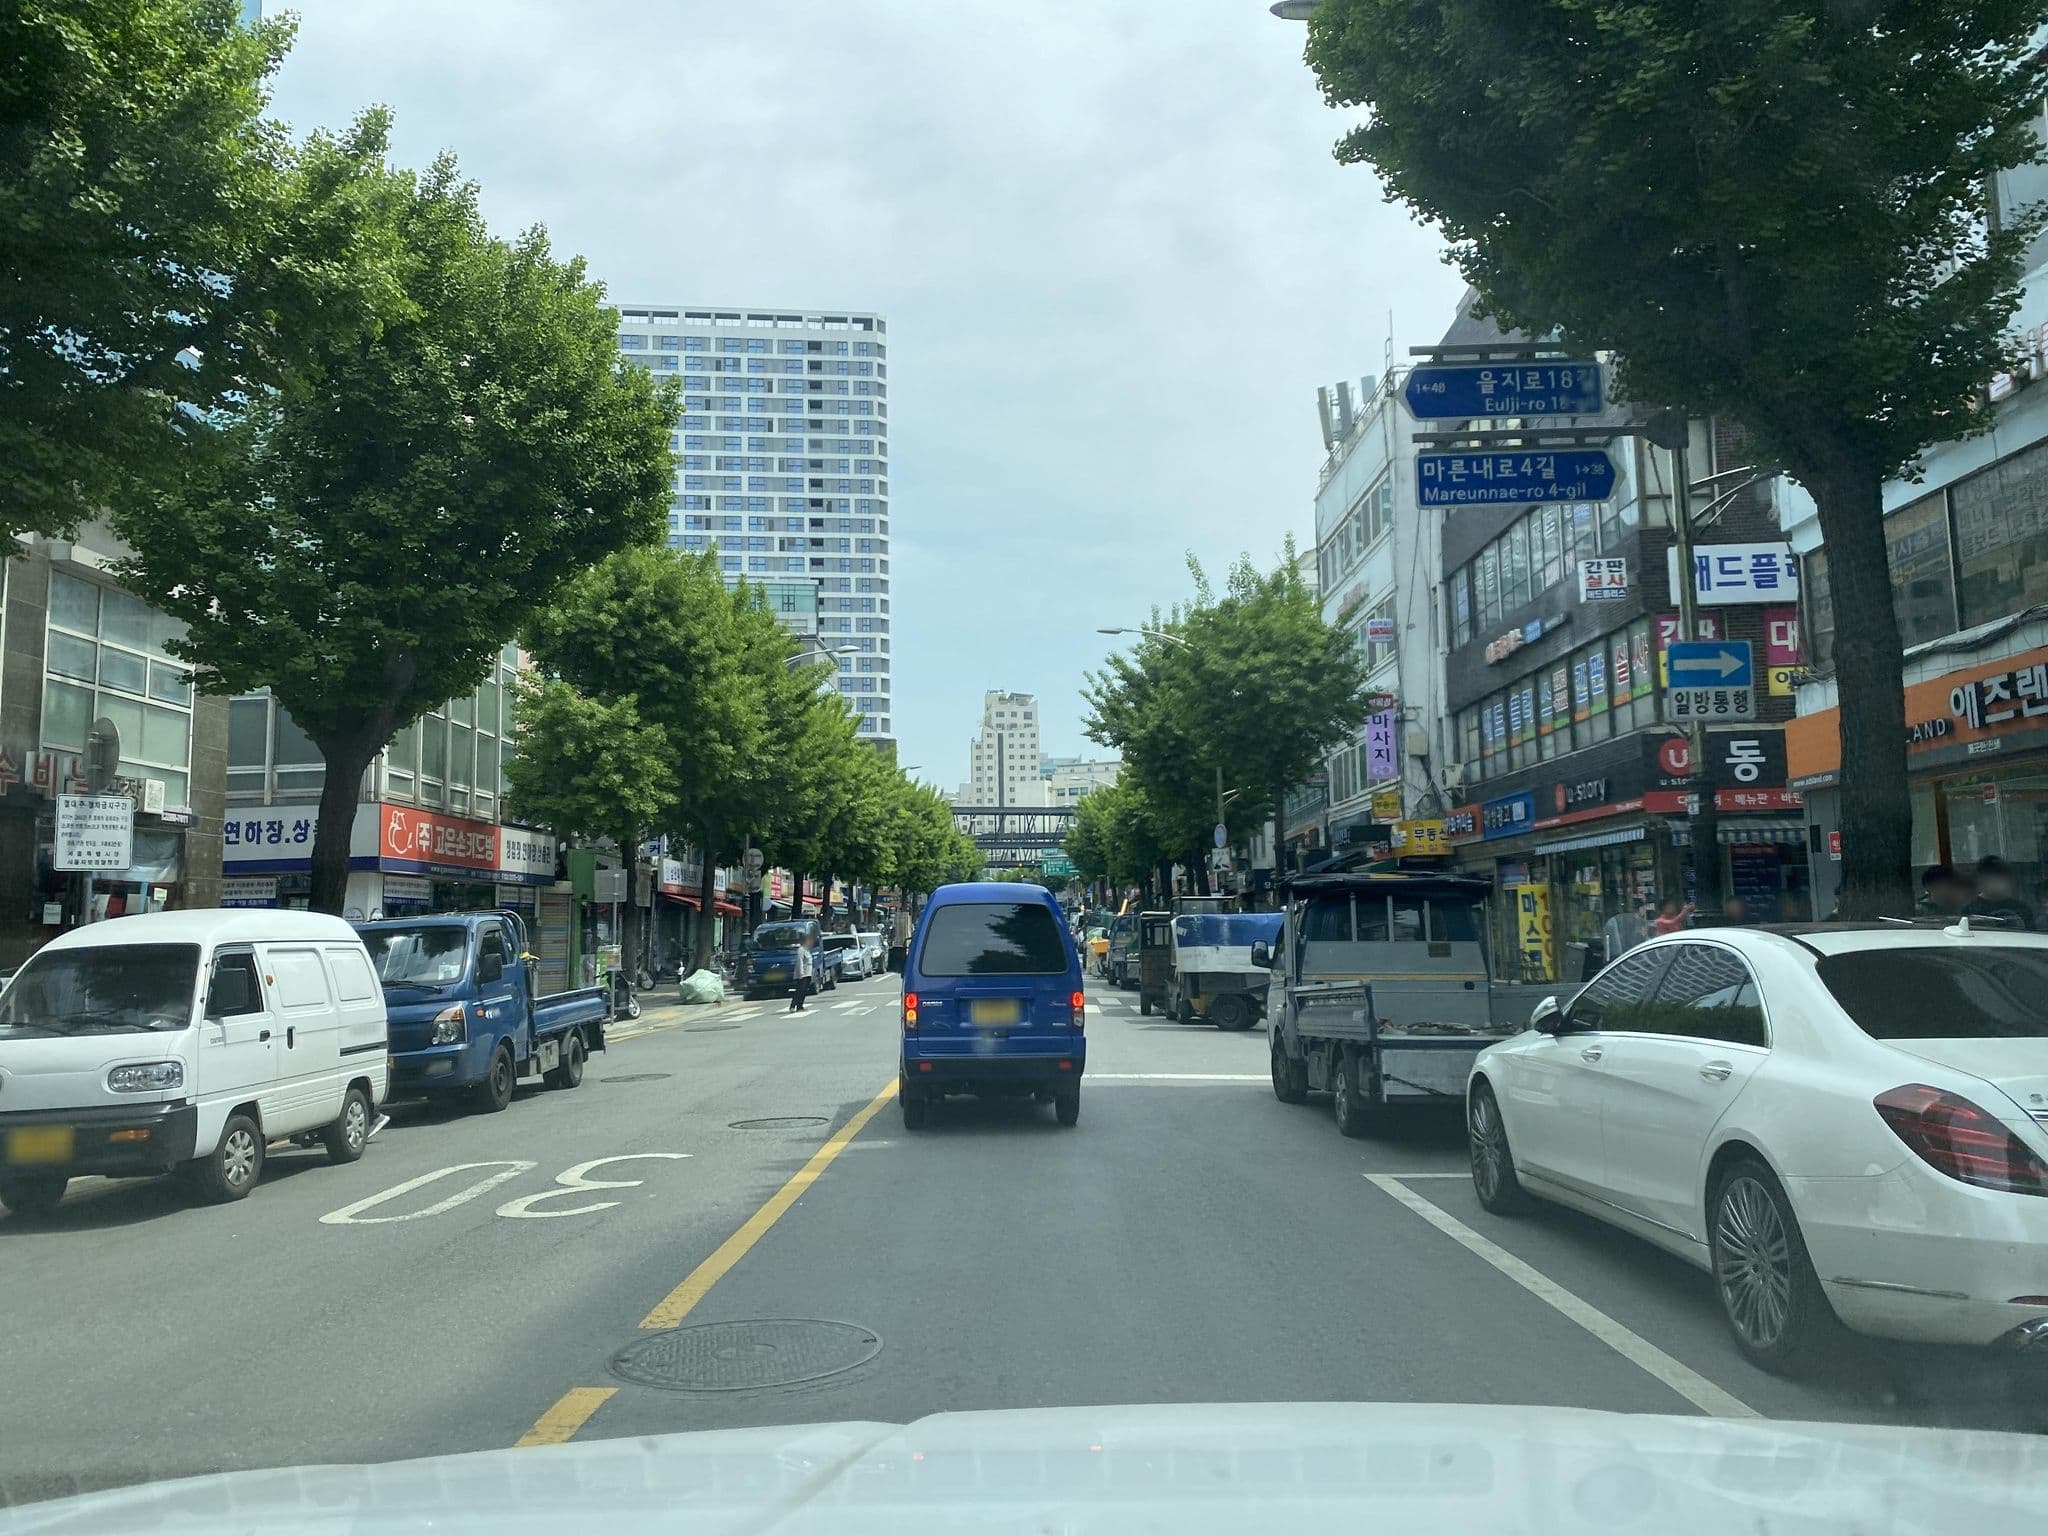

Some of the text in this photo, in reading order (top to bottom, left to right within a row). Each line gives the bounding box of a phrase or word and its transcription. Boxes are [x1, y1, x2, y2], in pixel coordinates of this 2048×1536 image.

[1485, 397, 1545, 414] Eulji-ro
[1423, 456, 1556, 482] 마른내로4길
[1424, 482, 1587, 502] Mareunnae-ro 4-gil
[1674, 690, 1748, 715] 일방통행
[1372, 713, 1391, 763] 마사지
[1905, 718, 1947, 743] AND
[1725, 740, 1767, 782] 동
[224, 817, 318, 846] 연하장.상
